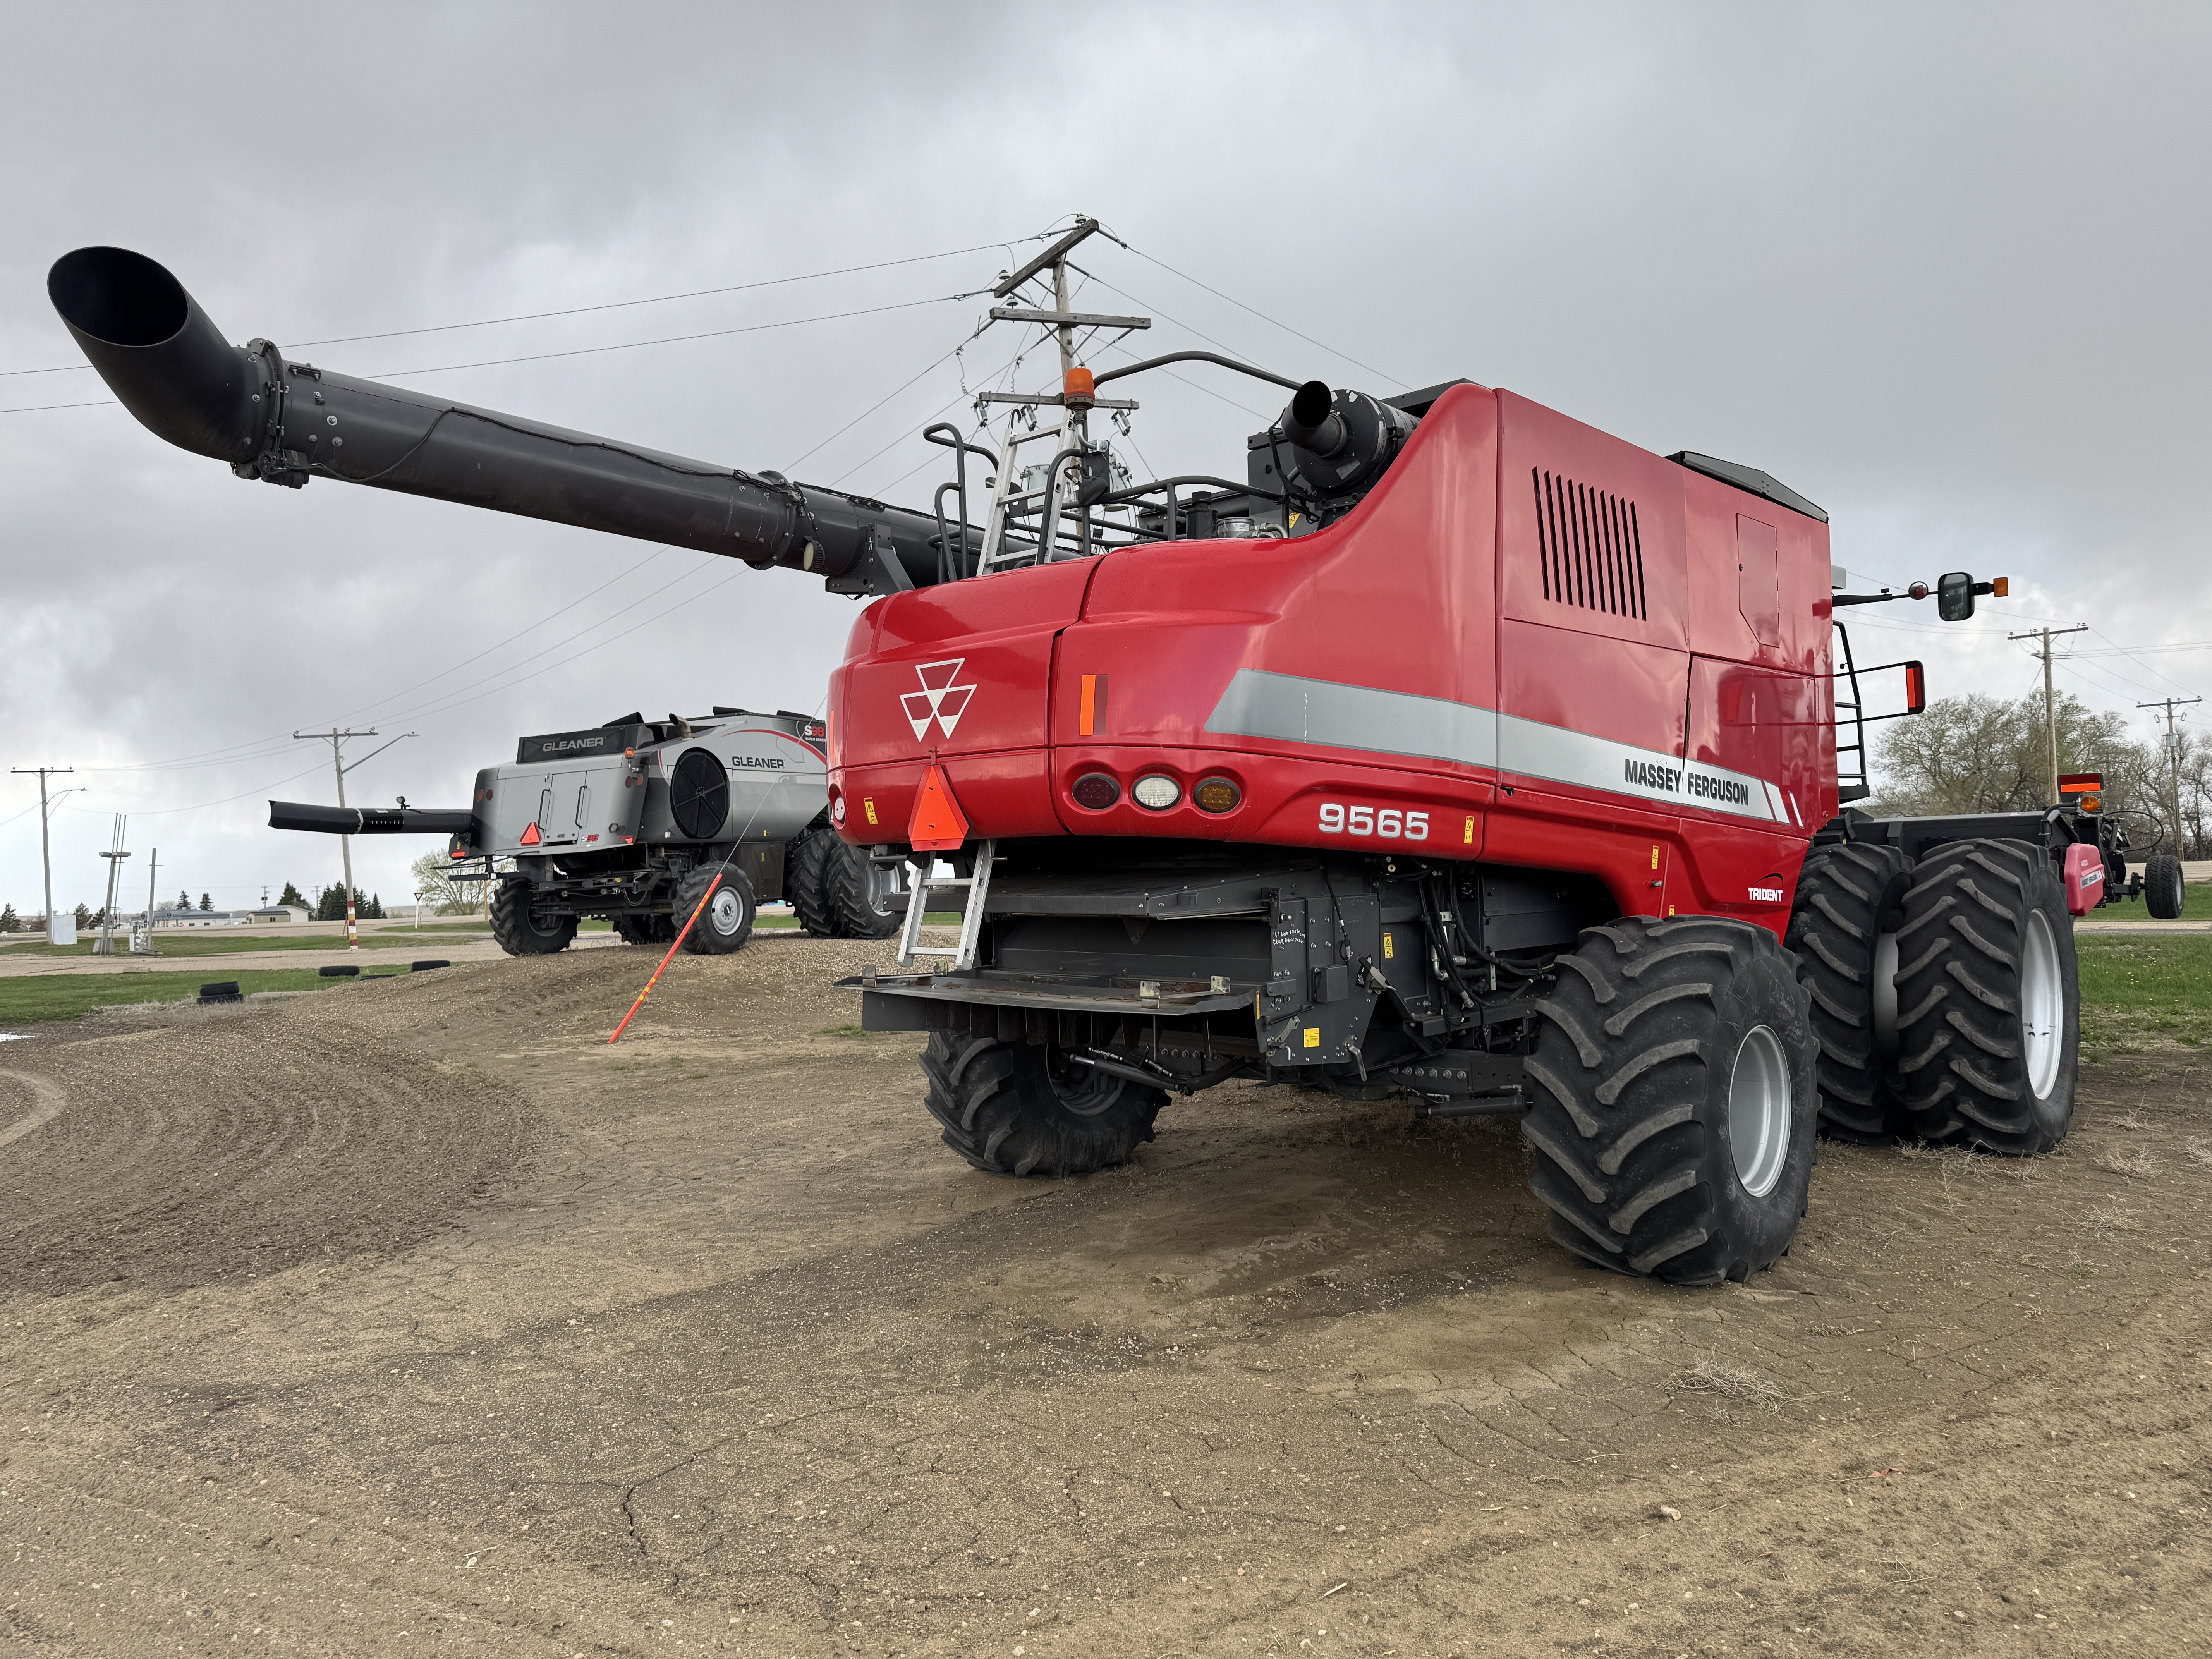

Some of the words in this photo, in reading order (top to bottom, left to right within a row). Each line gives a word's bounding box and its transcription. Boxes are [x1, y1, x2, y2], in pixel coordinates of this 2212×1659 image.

[804, 725, 825, 737] S98
[543, 737, 604, 752] GLEANER
[732, 756, 785, 769] GLEANER
[1625, 759, 1681, 793] MASSEY
[1688, 772, 1748, 806] FERGUSON
[1318, 803, 1430, 841] 9565
[581, 834, 599, 842] S98
[1748, 887, 1783, 902] TRIDENT
